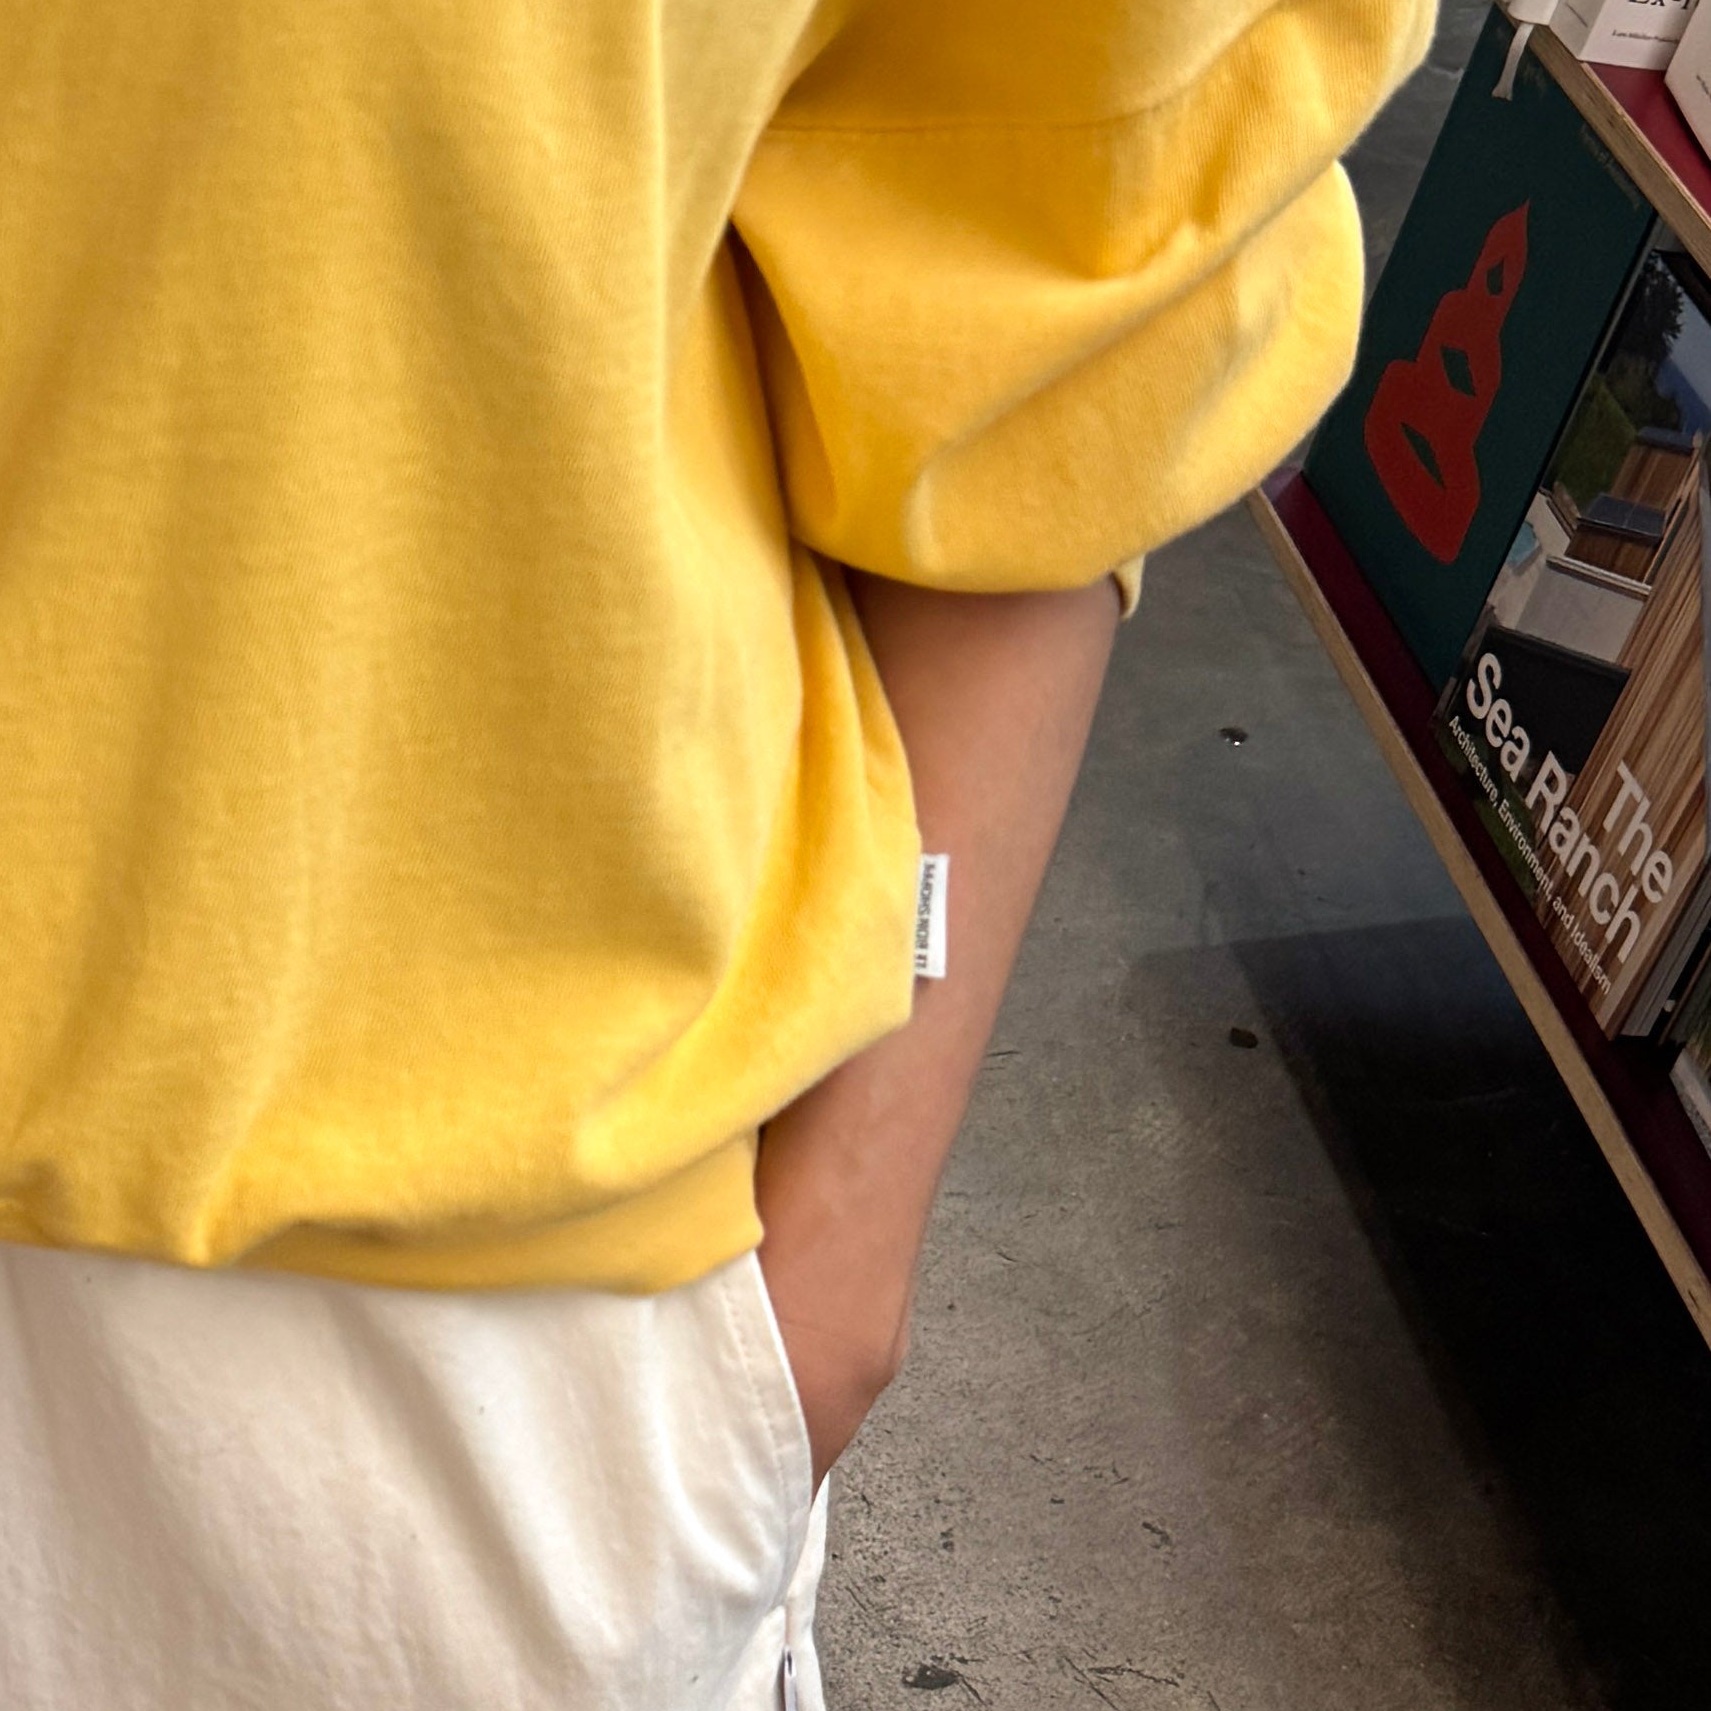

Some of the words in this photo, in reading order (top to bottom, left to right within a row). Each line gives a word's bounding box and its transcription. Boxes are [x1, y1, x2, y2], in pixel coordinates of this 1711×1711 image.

[1448, 715, 1499, 808] Architecture,
[1497, 799, 1554, 901] Environment,
[1552, 894, 1576, 930] and
[1570, 922, 1613, 995] Idealism
[1466, 652, 1531, 783] Sea
[1525, 751, 1641, 963] Ranch
[1602, 760, 1674, 904] The
